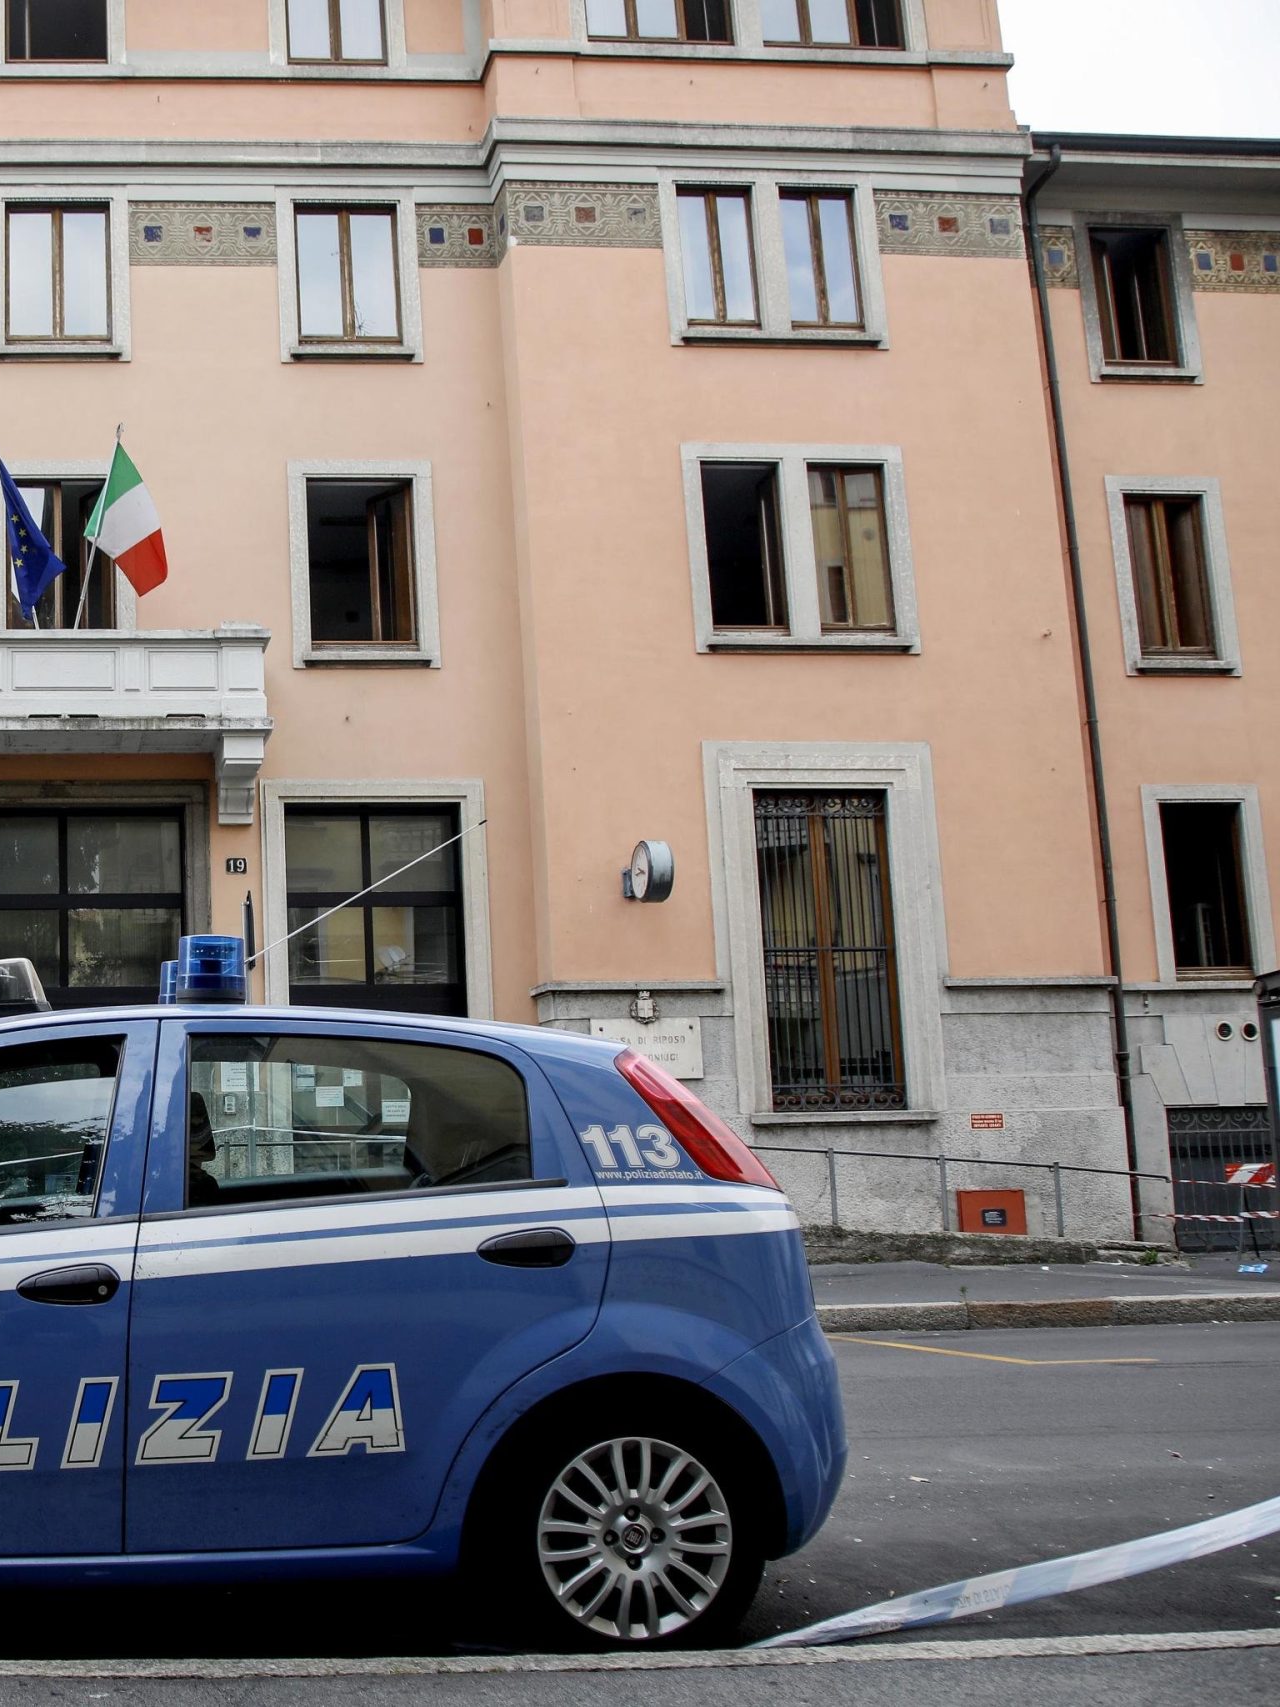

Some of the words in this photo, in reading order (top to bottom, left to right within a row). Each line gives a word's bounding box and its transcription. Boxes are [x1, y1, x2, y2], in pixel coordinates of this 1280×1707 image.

[228, 860, 245, 872] 19
[653, 1035, 686, 1044] RIPOSO
[580, 1123, 680, 1168] 113
[594, 1168, 704, 1181] www.poliziadistato.it
